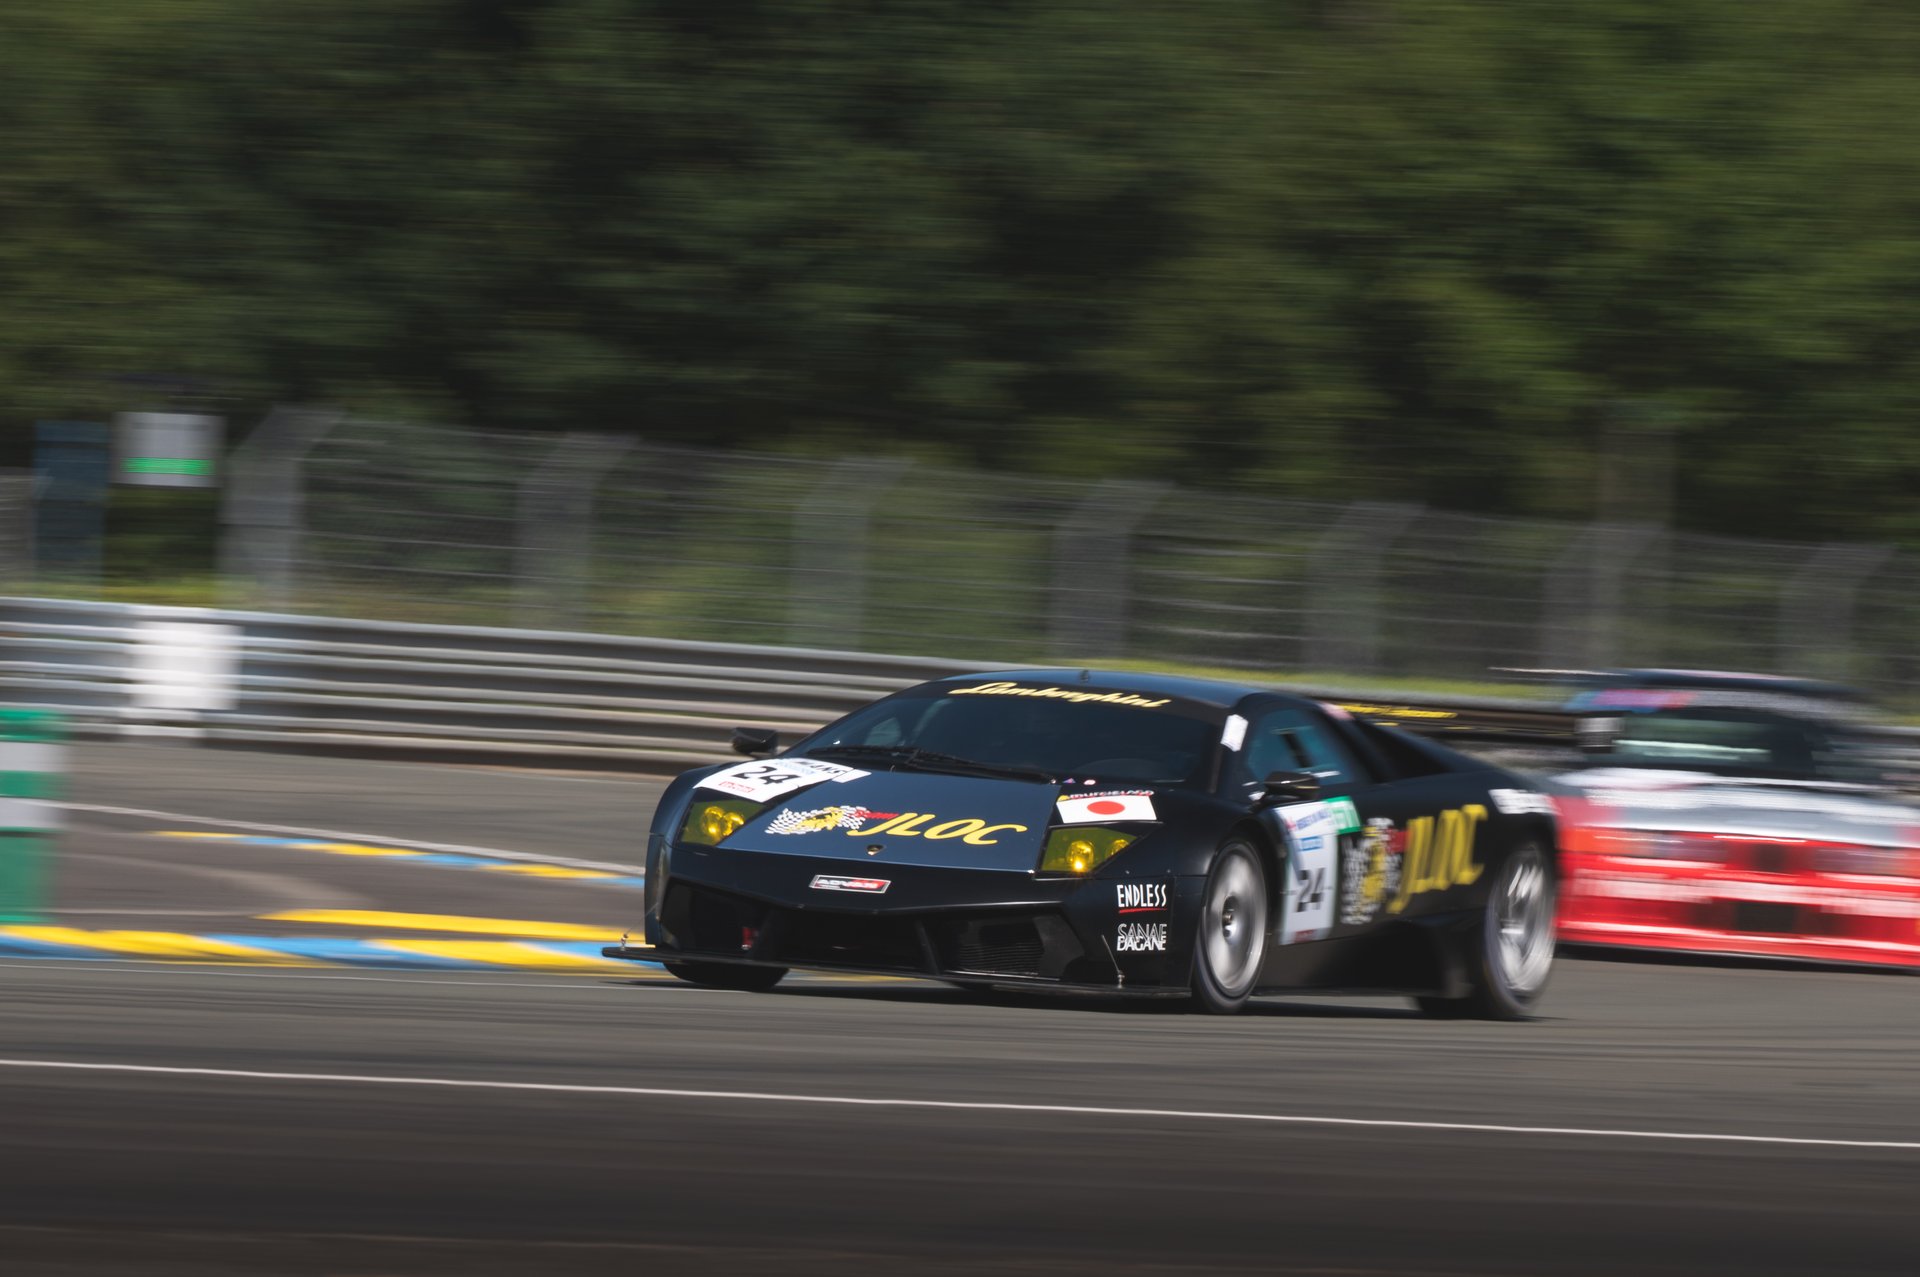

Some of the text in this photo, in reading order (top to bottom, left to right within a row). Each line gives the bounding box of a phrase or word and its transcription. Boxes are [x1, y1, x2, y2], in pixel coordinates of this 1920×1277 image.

[948, 681, 1171, 708] Lamborghini
[732, 766, 801, 785] 24
[846, 812, 1028, 845] JLOC
[1116, 884, 1167, 907] ENDLESS
[1296, 867, 1326, 912] 24
